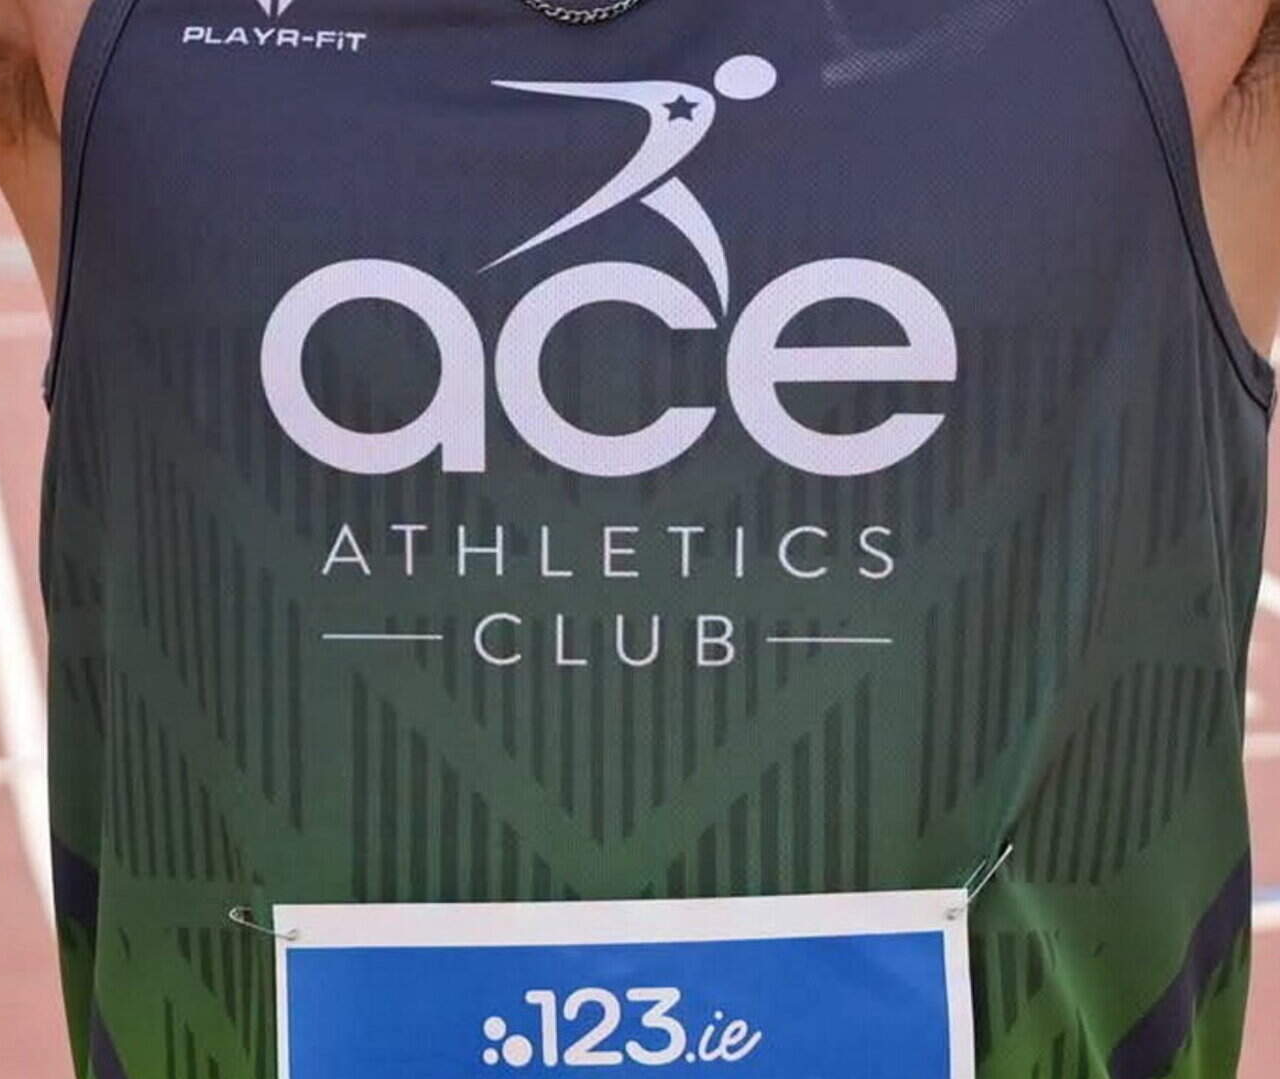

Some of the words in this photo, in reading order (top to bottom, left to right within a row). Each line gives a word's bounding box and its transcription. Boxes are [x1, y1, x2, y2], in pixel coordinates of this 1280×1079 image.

[260, 258, 957, 477] ace
[322, 524, 895, 580] ATHLETICS
[473, 612, 736, 667] CLUB
[524, 986, 762, 1067] 123.ie
